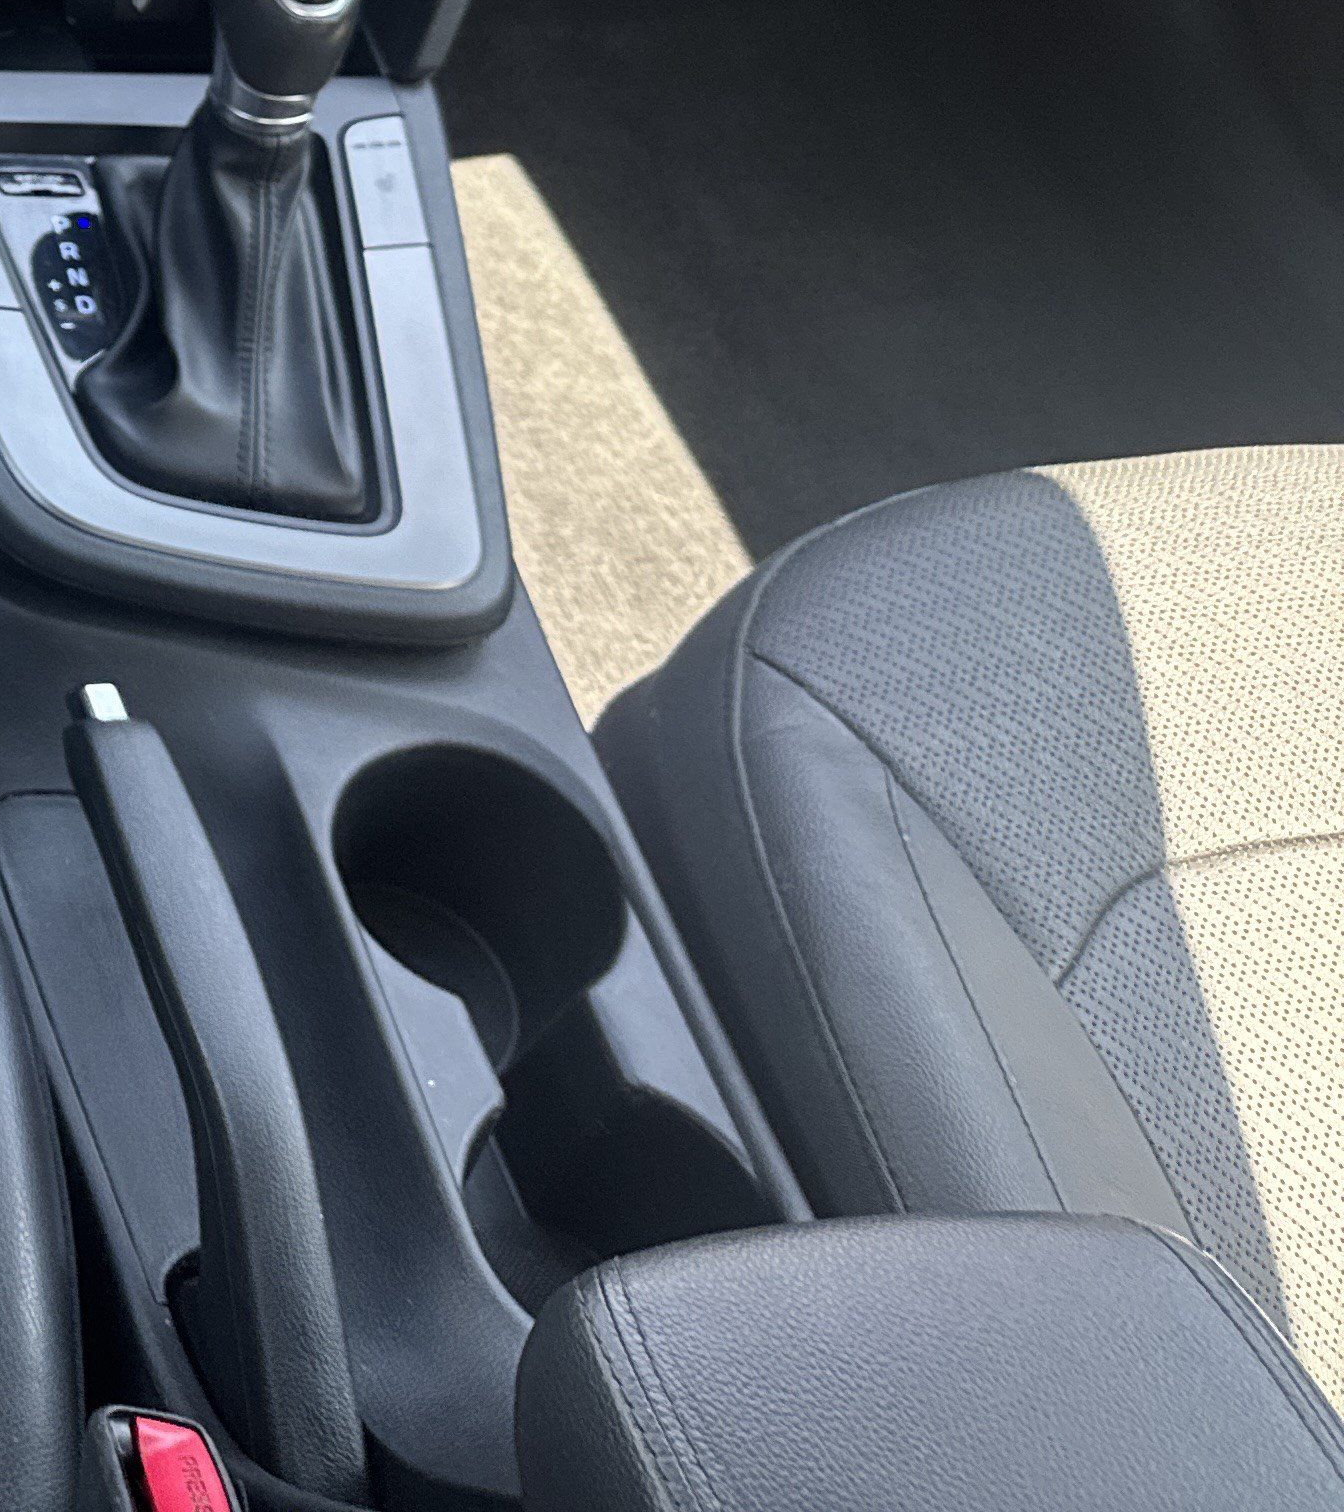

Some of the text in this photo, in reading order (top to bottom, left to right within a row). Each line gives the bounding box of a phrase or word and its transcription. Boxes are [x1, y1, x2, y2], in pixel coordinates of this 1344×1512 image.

[51, 215, 69, 234] P
[59, 242, 80, 260] R
[66, 268, 89, 286] N
[74, 295, 96, 314] D
